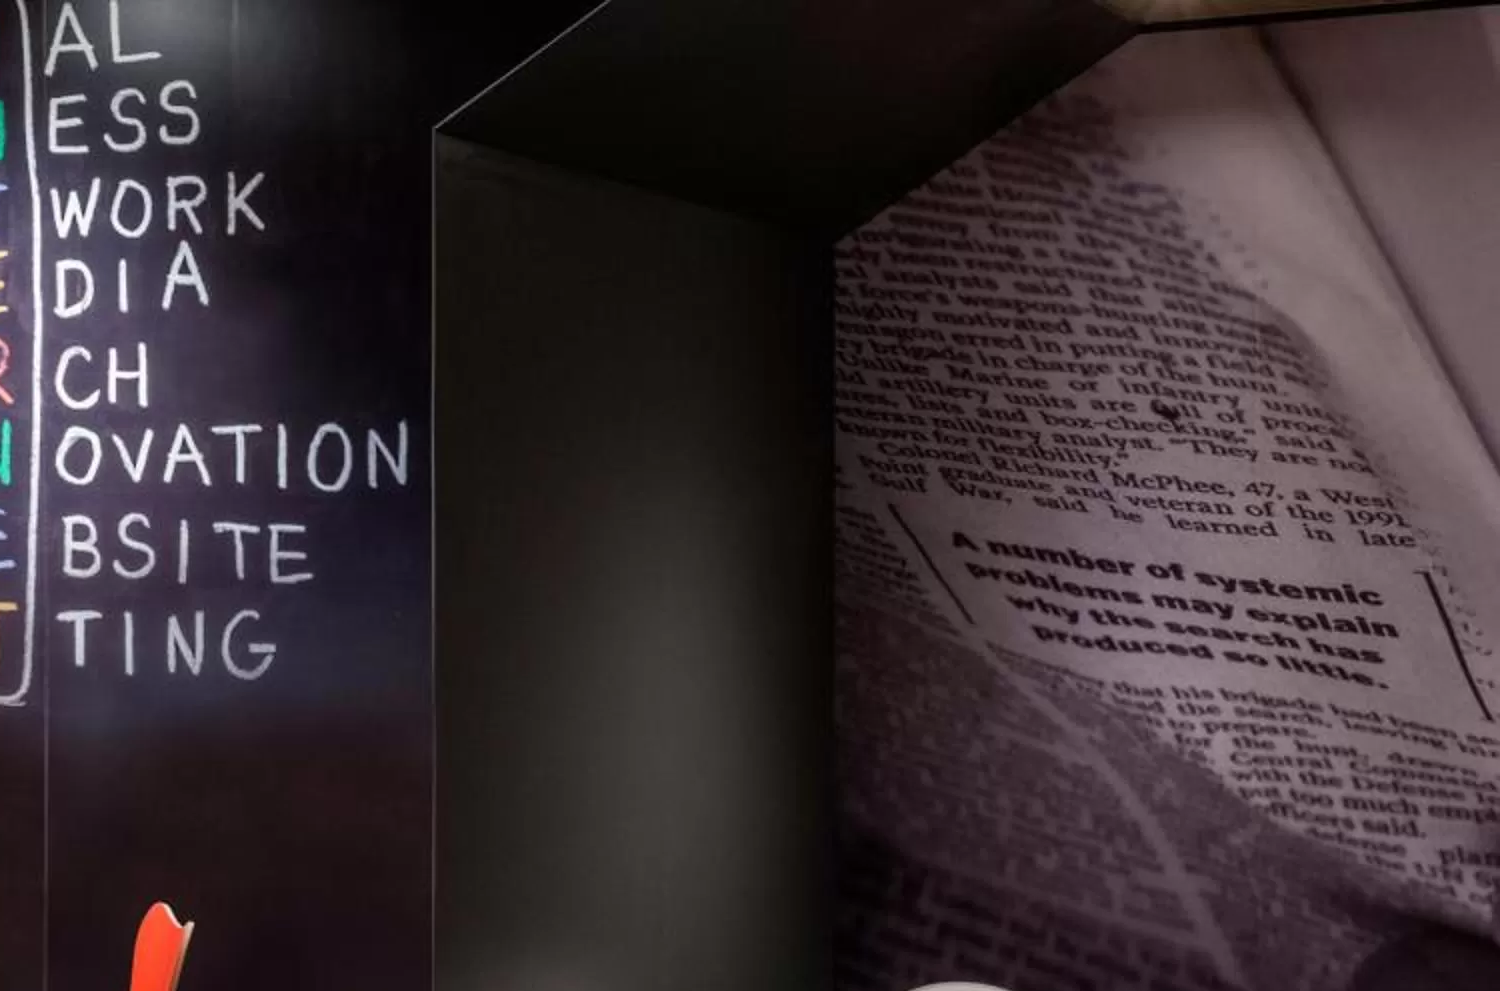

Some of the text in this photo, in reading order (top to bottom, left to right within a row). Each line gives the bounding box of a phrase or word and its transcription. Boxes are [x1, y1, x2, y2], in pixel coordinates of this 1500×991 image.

[932, 311, 1073, 334] motivated
[1085, 323, 1141, 341] and
[1030, 335, 1062, 353] in
[877, 442, 981, 466] Colonel
[989, 453, 1101, 484] Richard
[1293, 488, 1313, 502] a
[1317, 487, 1397, 511] West
[1033, 496, 1089, 514] said
[1108, 503, 1145, 524] he
[1163, 512, 1279, 538] learned
[1301, 523, 1336, 544] in
[1357, 528, 1418, 549] late
[1064, 485, 1116, 503] and
[1123, 494, 1235, 517] veteran
[1244, 500, 1276, 518] of
[1285, 503, 1335, 524] the
[1345, 508, 1412, 530] 1991
[952, 531, 1382, 608] A number of systemic
[964, 560, 1400, 640] problems may explain
[1005, 594, 1386, 666] why the search has
[1030, 623, 1390, 691] produced so little.
[1342, 796, 1420, 817] much
